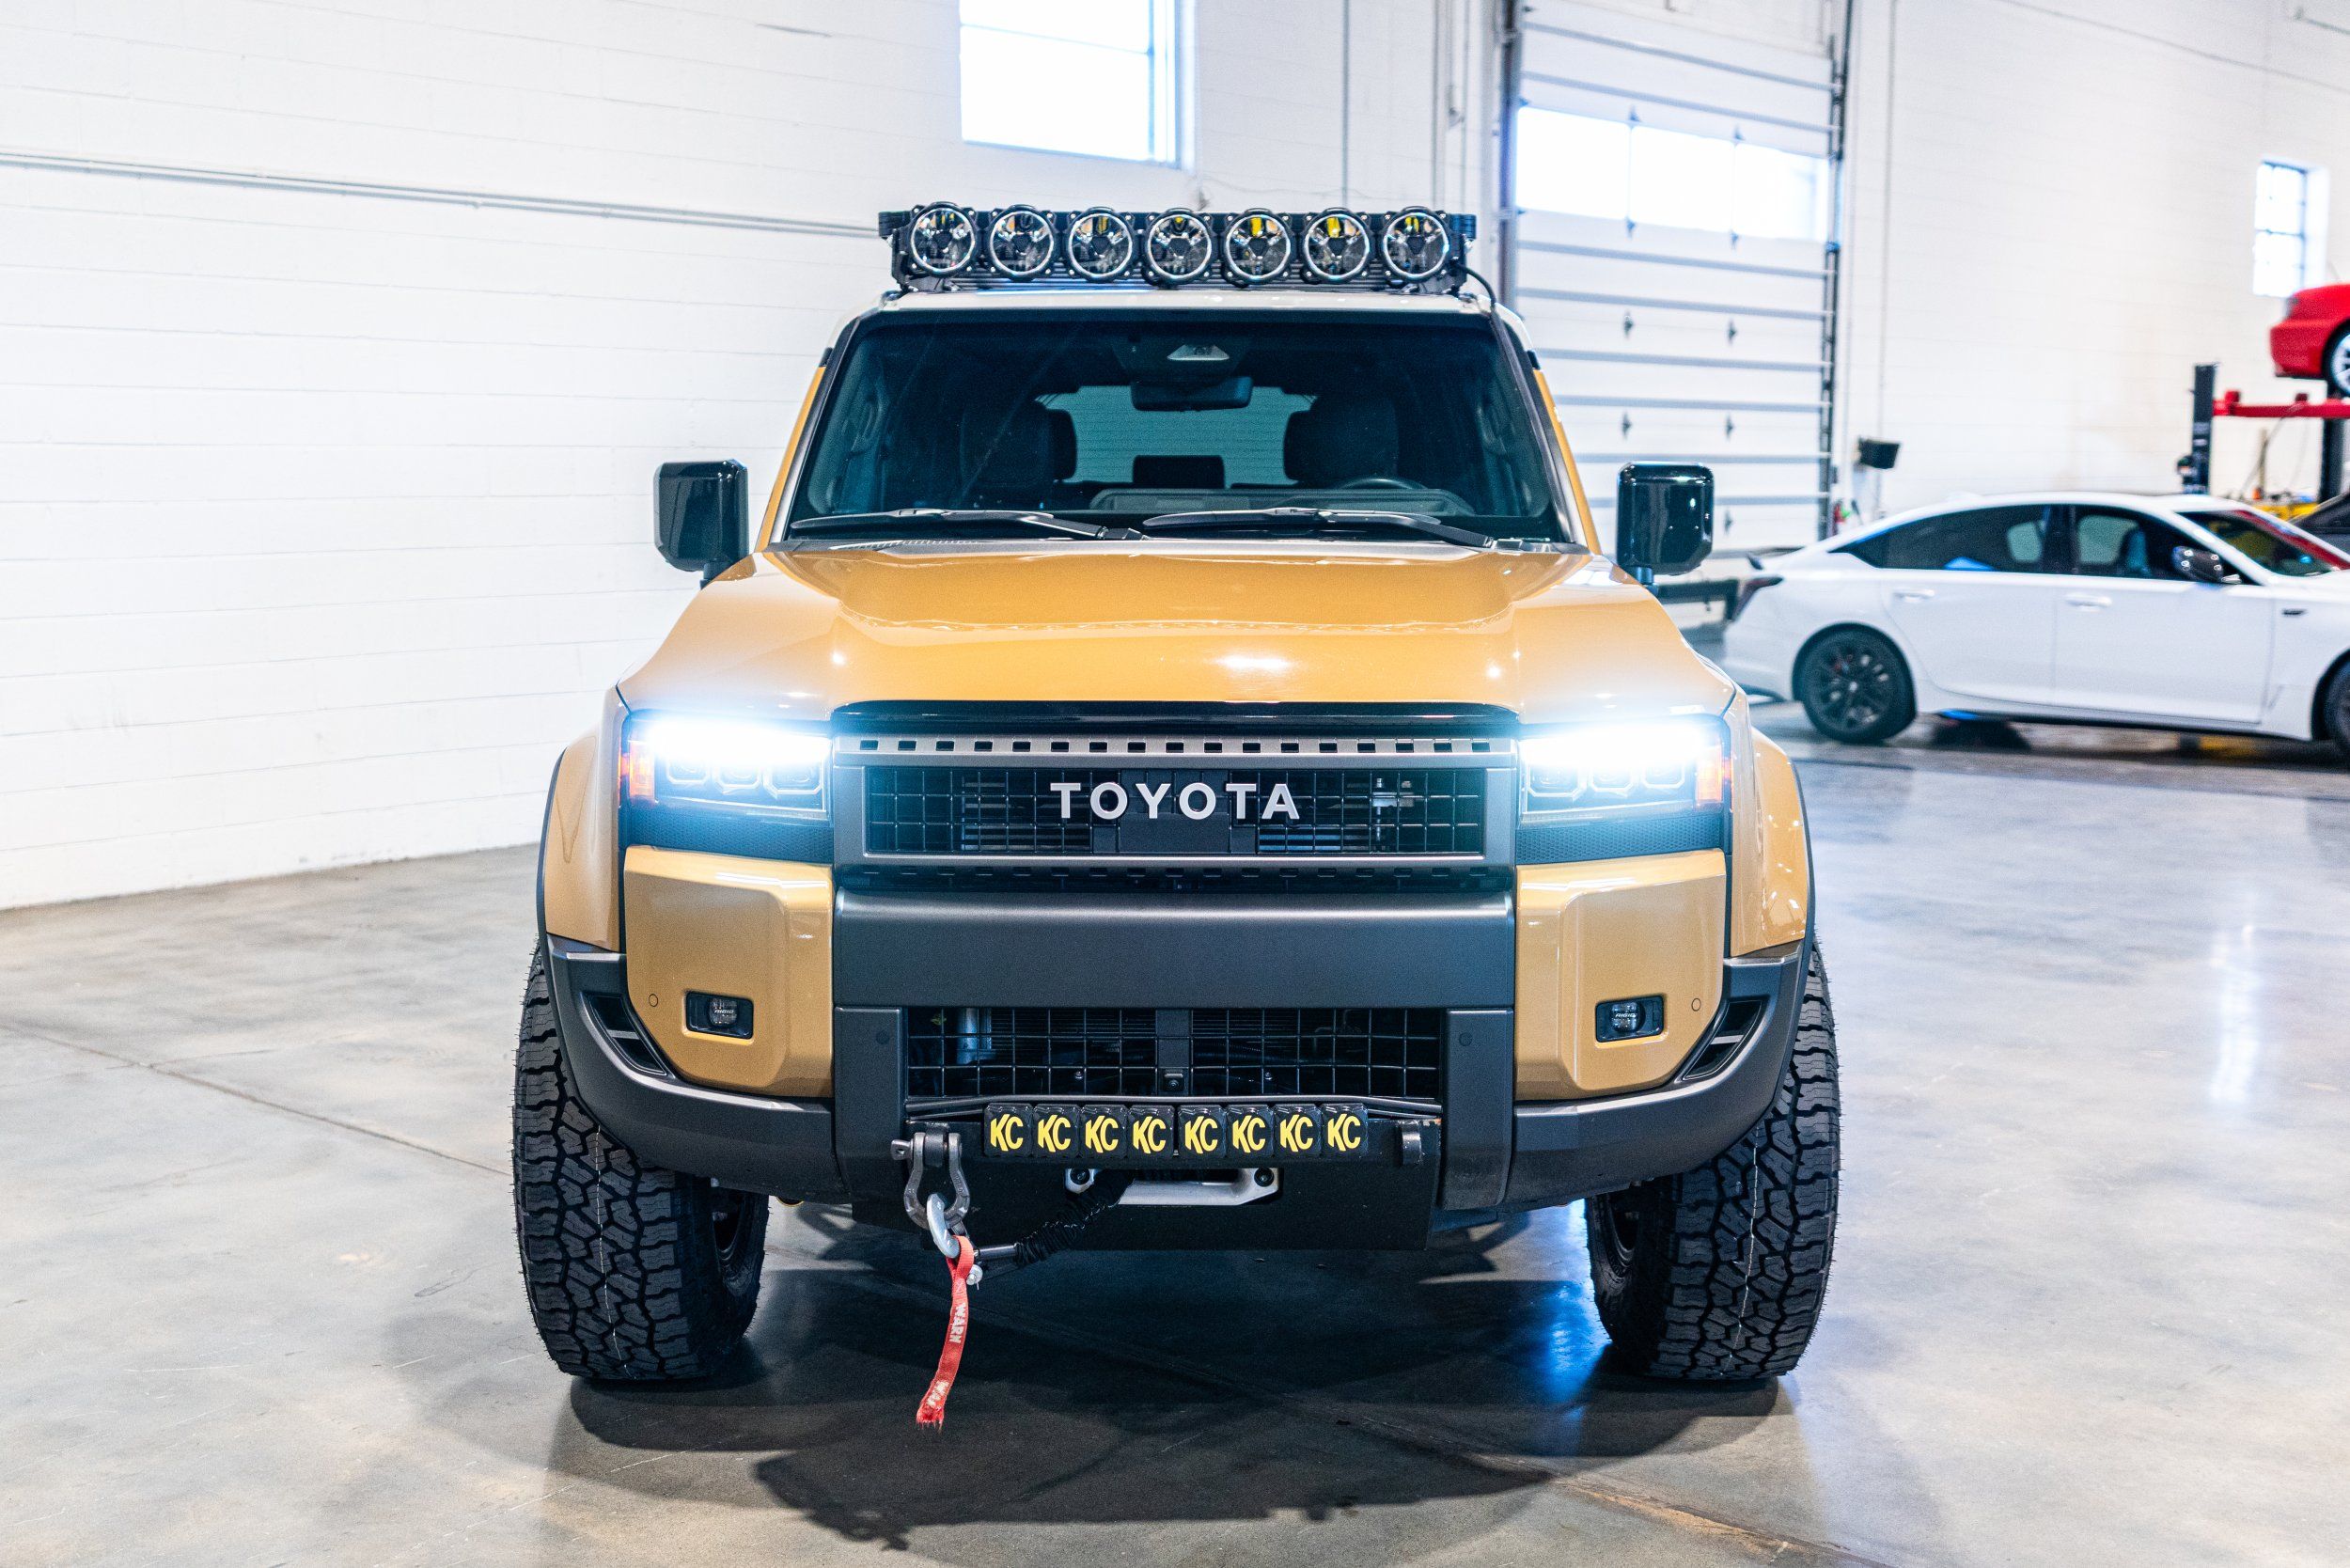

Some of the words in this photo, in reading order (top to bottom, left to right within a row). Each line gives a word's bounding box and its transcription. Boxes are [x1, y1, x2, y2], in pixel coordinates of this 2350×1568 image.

[1050, 781, 1300, 821] TOYOTA
[990, 1114, 1024, 1152] KC
[1037, 1114, 1071, 1152] KC
[1085, 1115, 1119, 1153] KC
[1133, 1116, 1167, 1154] KC
[1184, 1116, 1218, 1154] KC
[1231, 1115, 1266, 1153] KC
[1279, 1114, 1313, 1152] KC
[1327, 1113, 1361, 1152] KC
[948, 1302, 966, 1344] WARN
